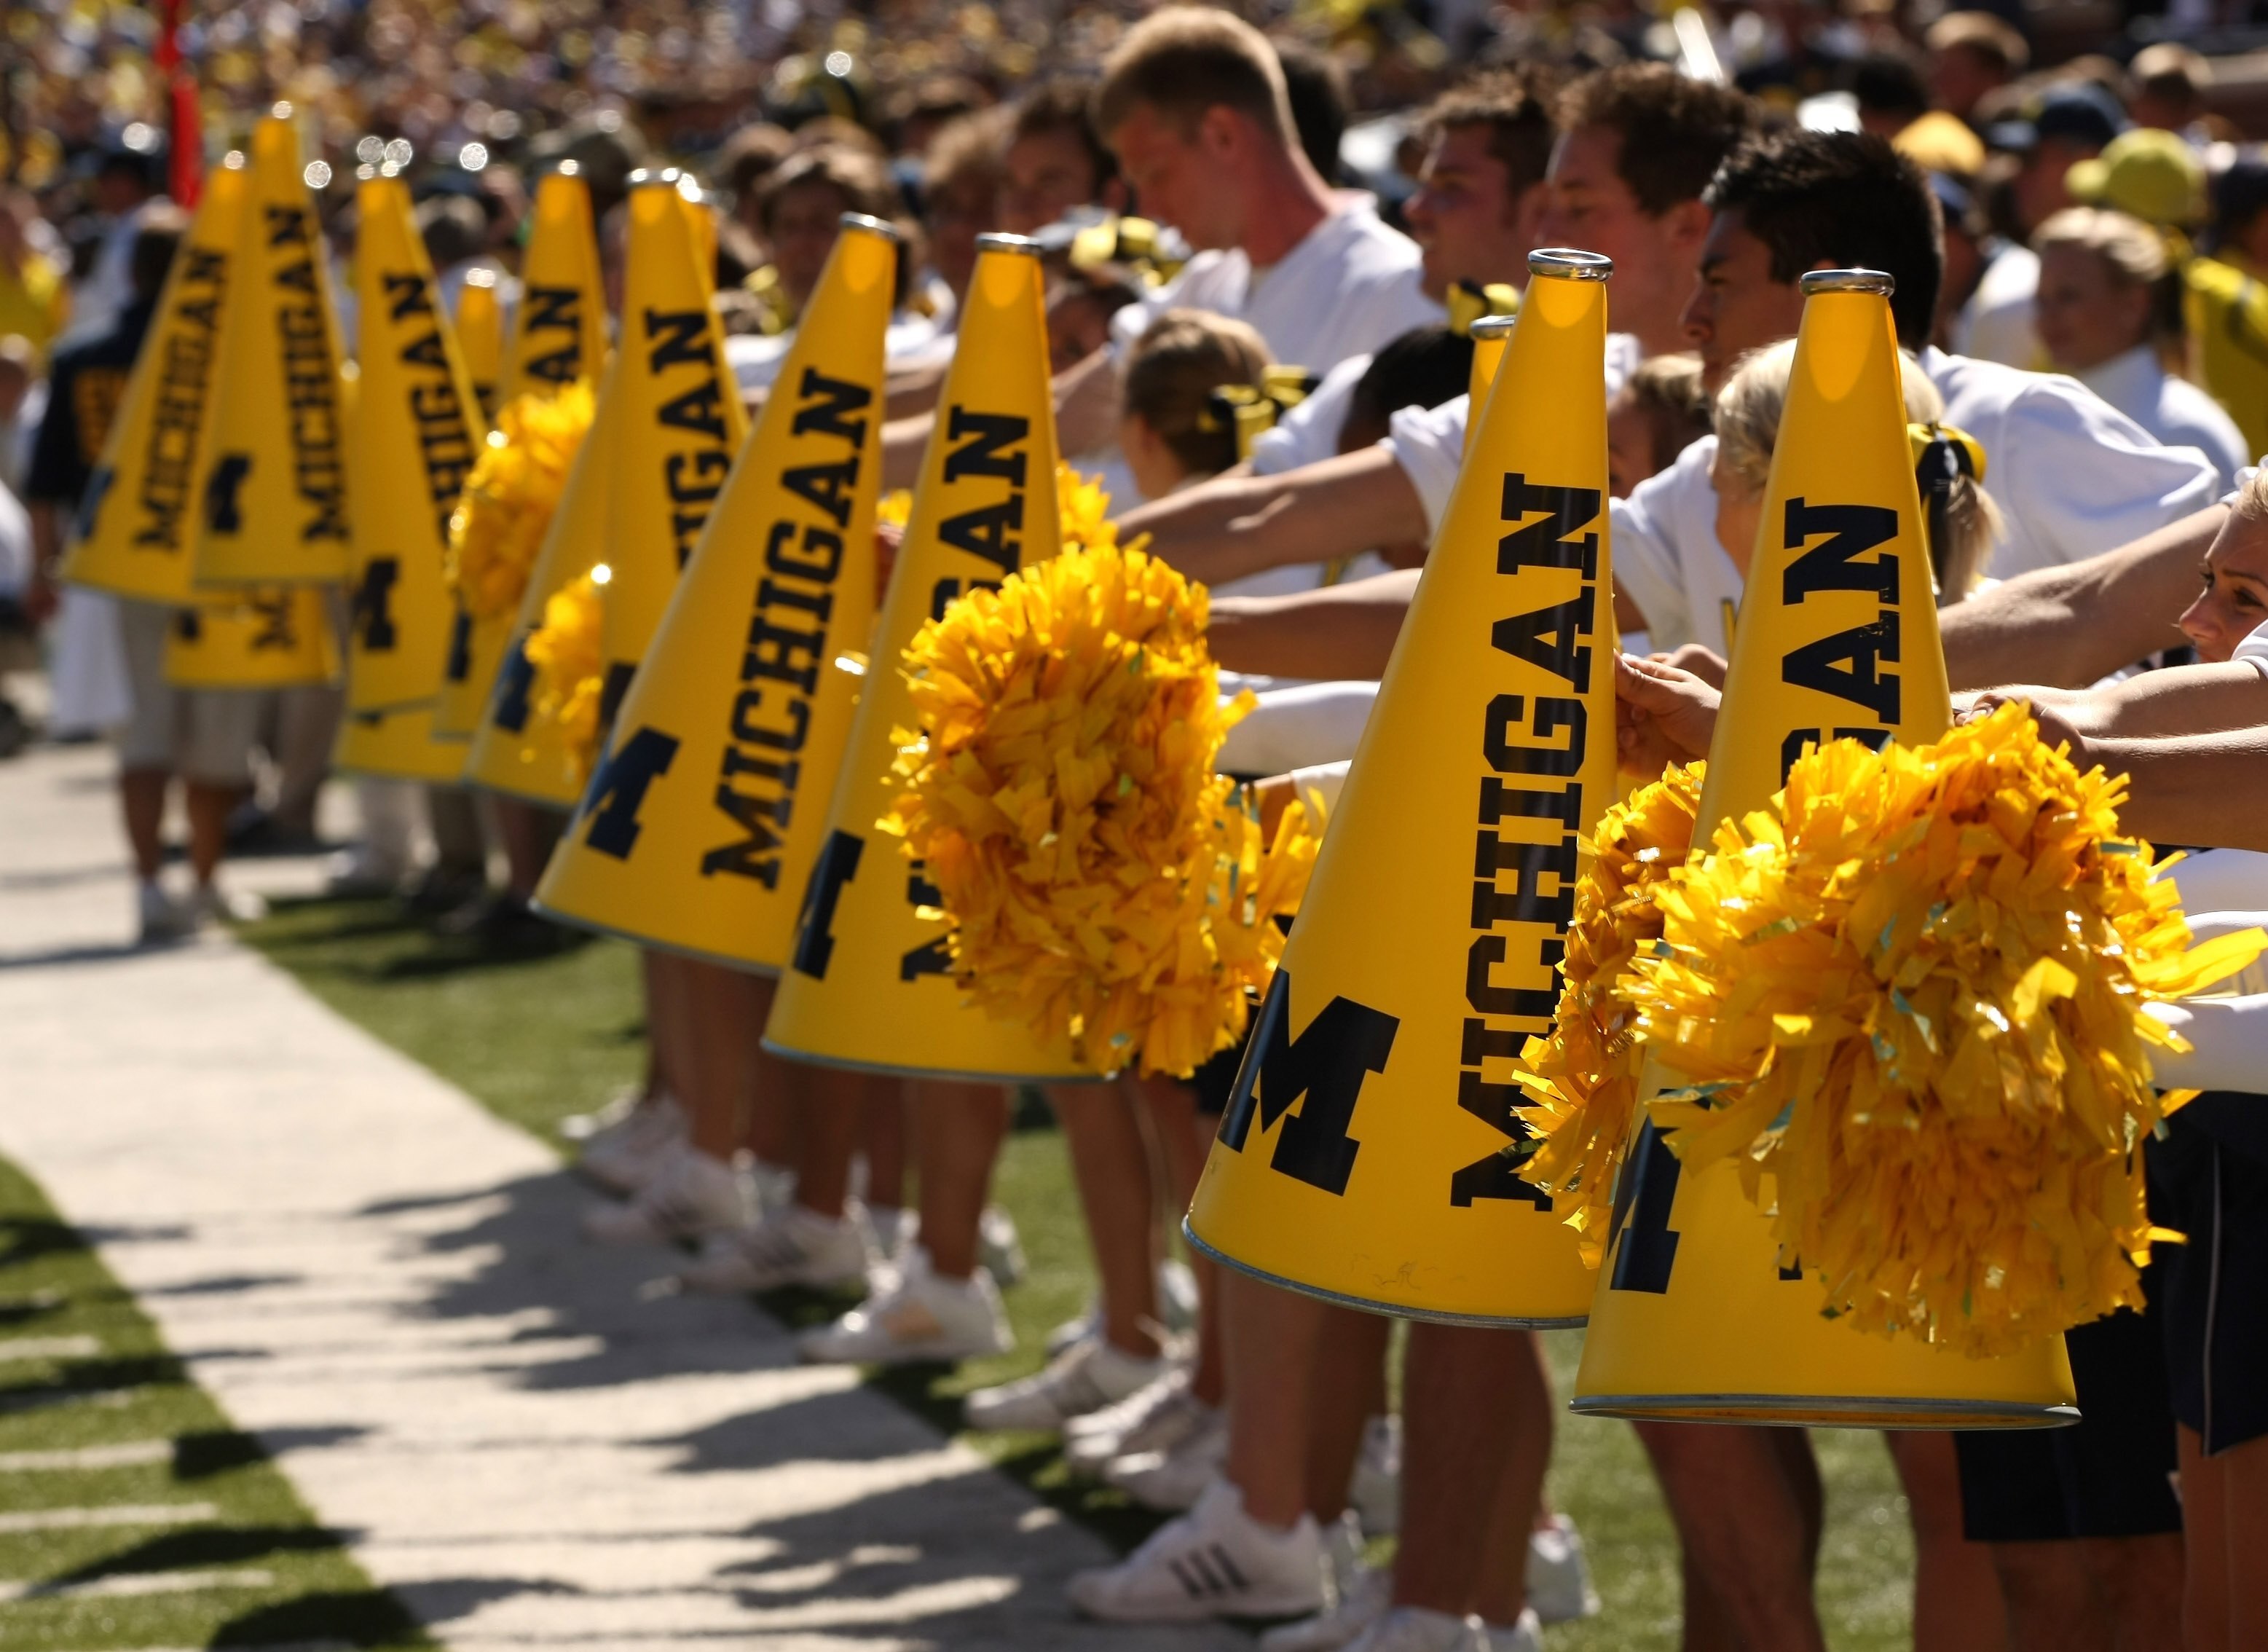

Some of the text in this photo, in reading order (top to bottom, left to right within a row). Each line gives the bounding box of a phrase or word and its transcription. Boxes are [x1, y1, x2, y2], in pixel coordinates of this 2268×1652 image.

[700, 368, 872, 892] MICHIGAN
[1450, 473, 1601, 1211] MICHIGAN
[1218, 968, 1400, 1196] M
